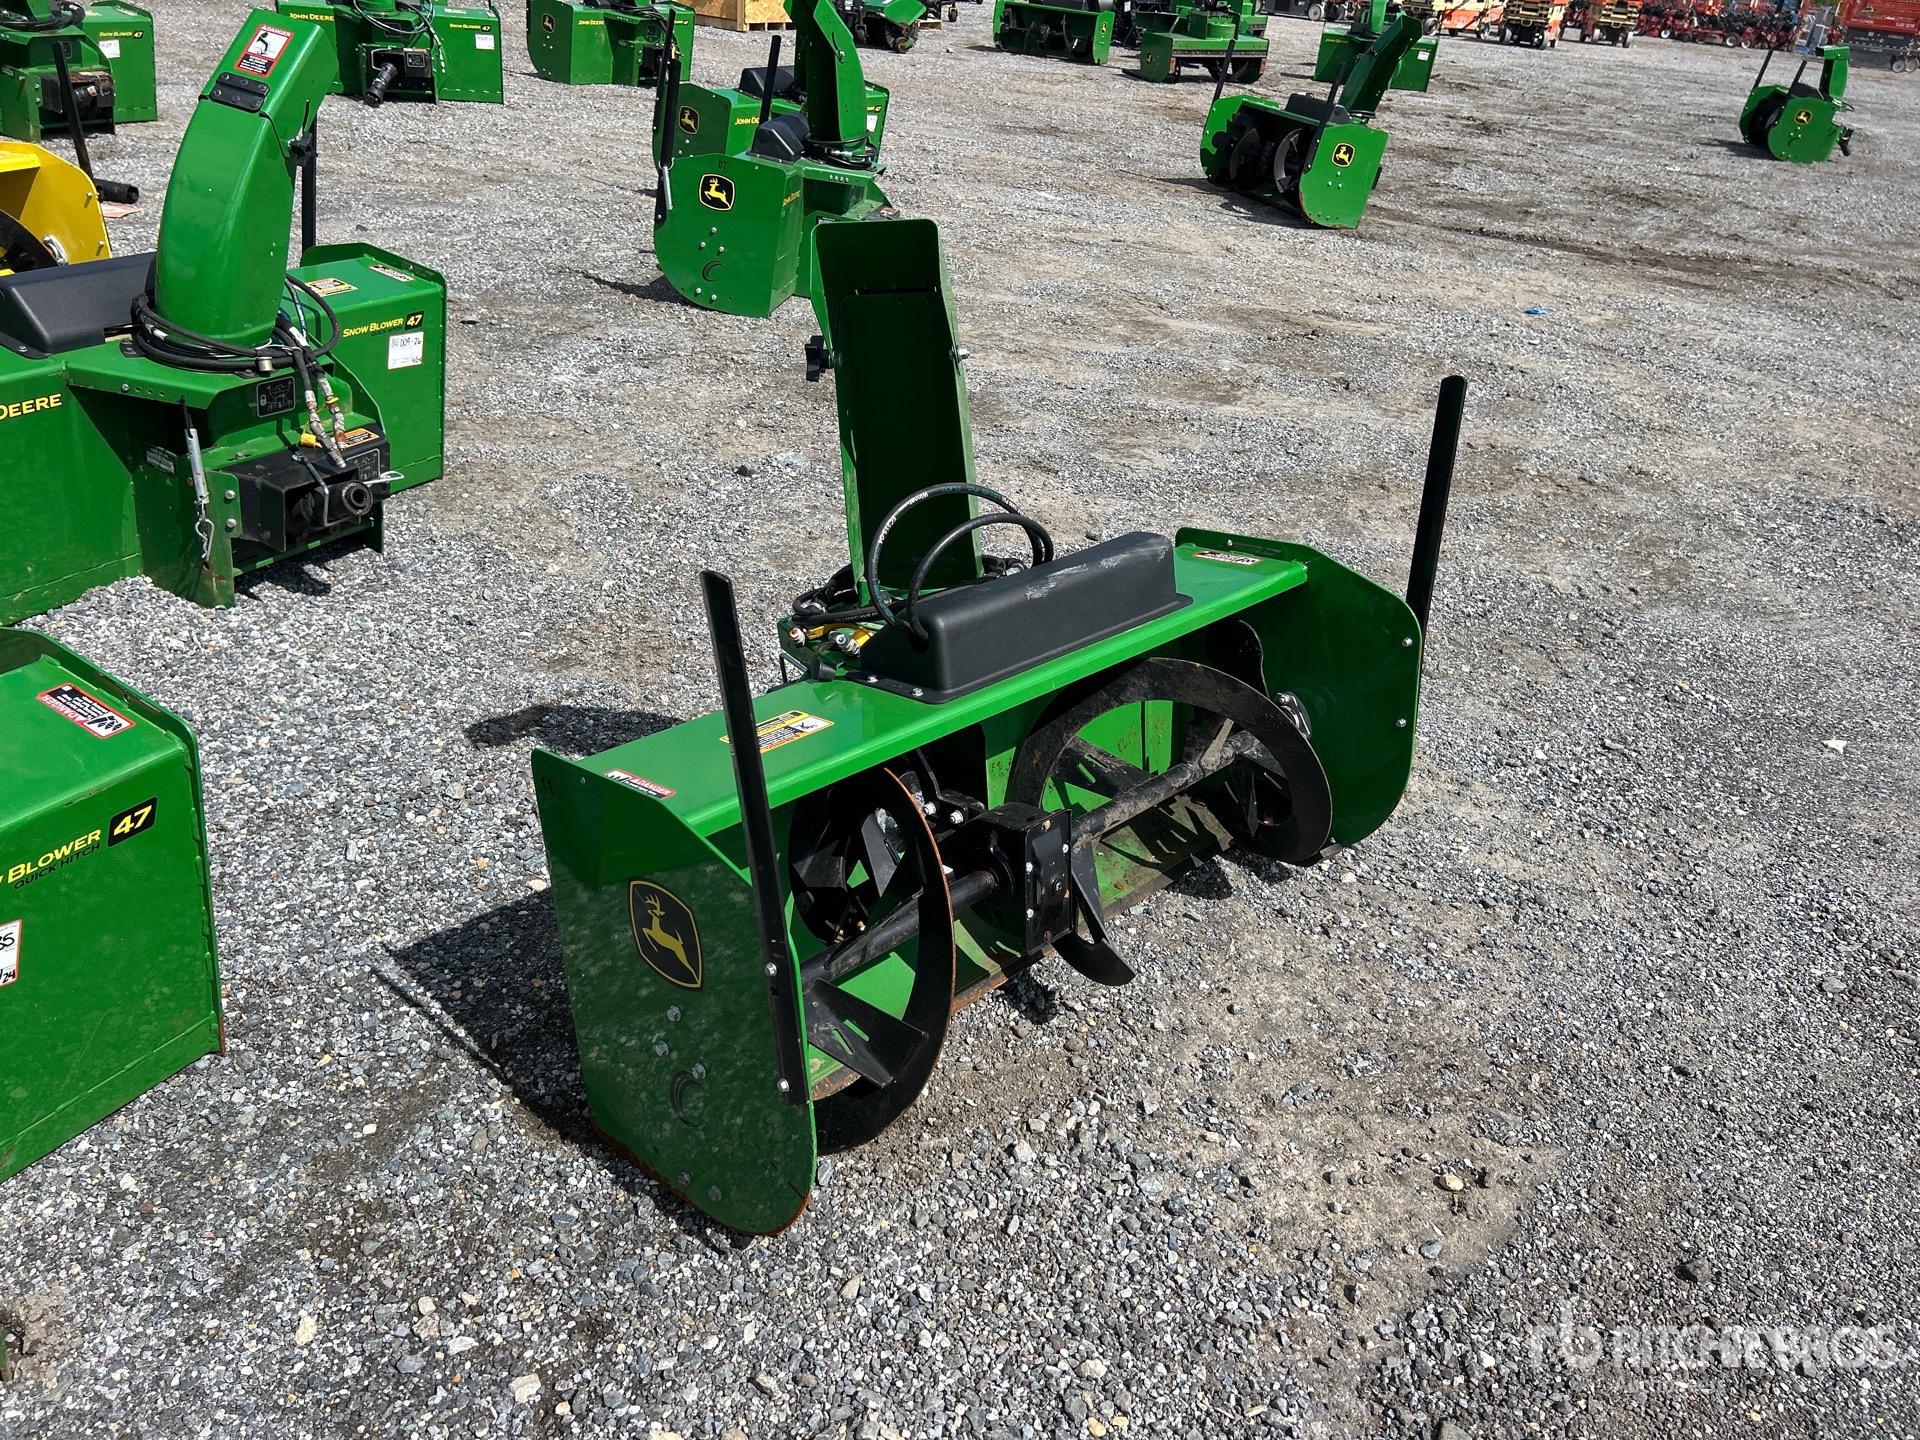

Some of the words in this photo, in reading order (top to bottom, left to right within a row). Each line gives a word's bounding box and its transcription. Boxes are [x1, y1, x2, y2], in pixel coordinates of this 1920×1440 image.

[309, 13, 335, 22] DEERE
[734, 117, 751, 125] JOHN
[342, 326, 369, 338] SNOW
[369, 317, 404, 332] BLOWER
[406, 314, 423, 327] 47
[0, 393, 62, 421] DEERE
[41, 694, 77, 719] DANGER
[7, 828, 102, 884] BLOWER
[113, 804, 153, 836] 47
[13, 864, 57, 890] QUICK
[60, 842, 100, 868] HITCH
